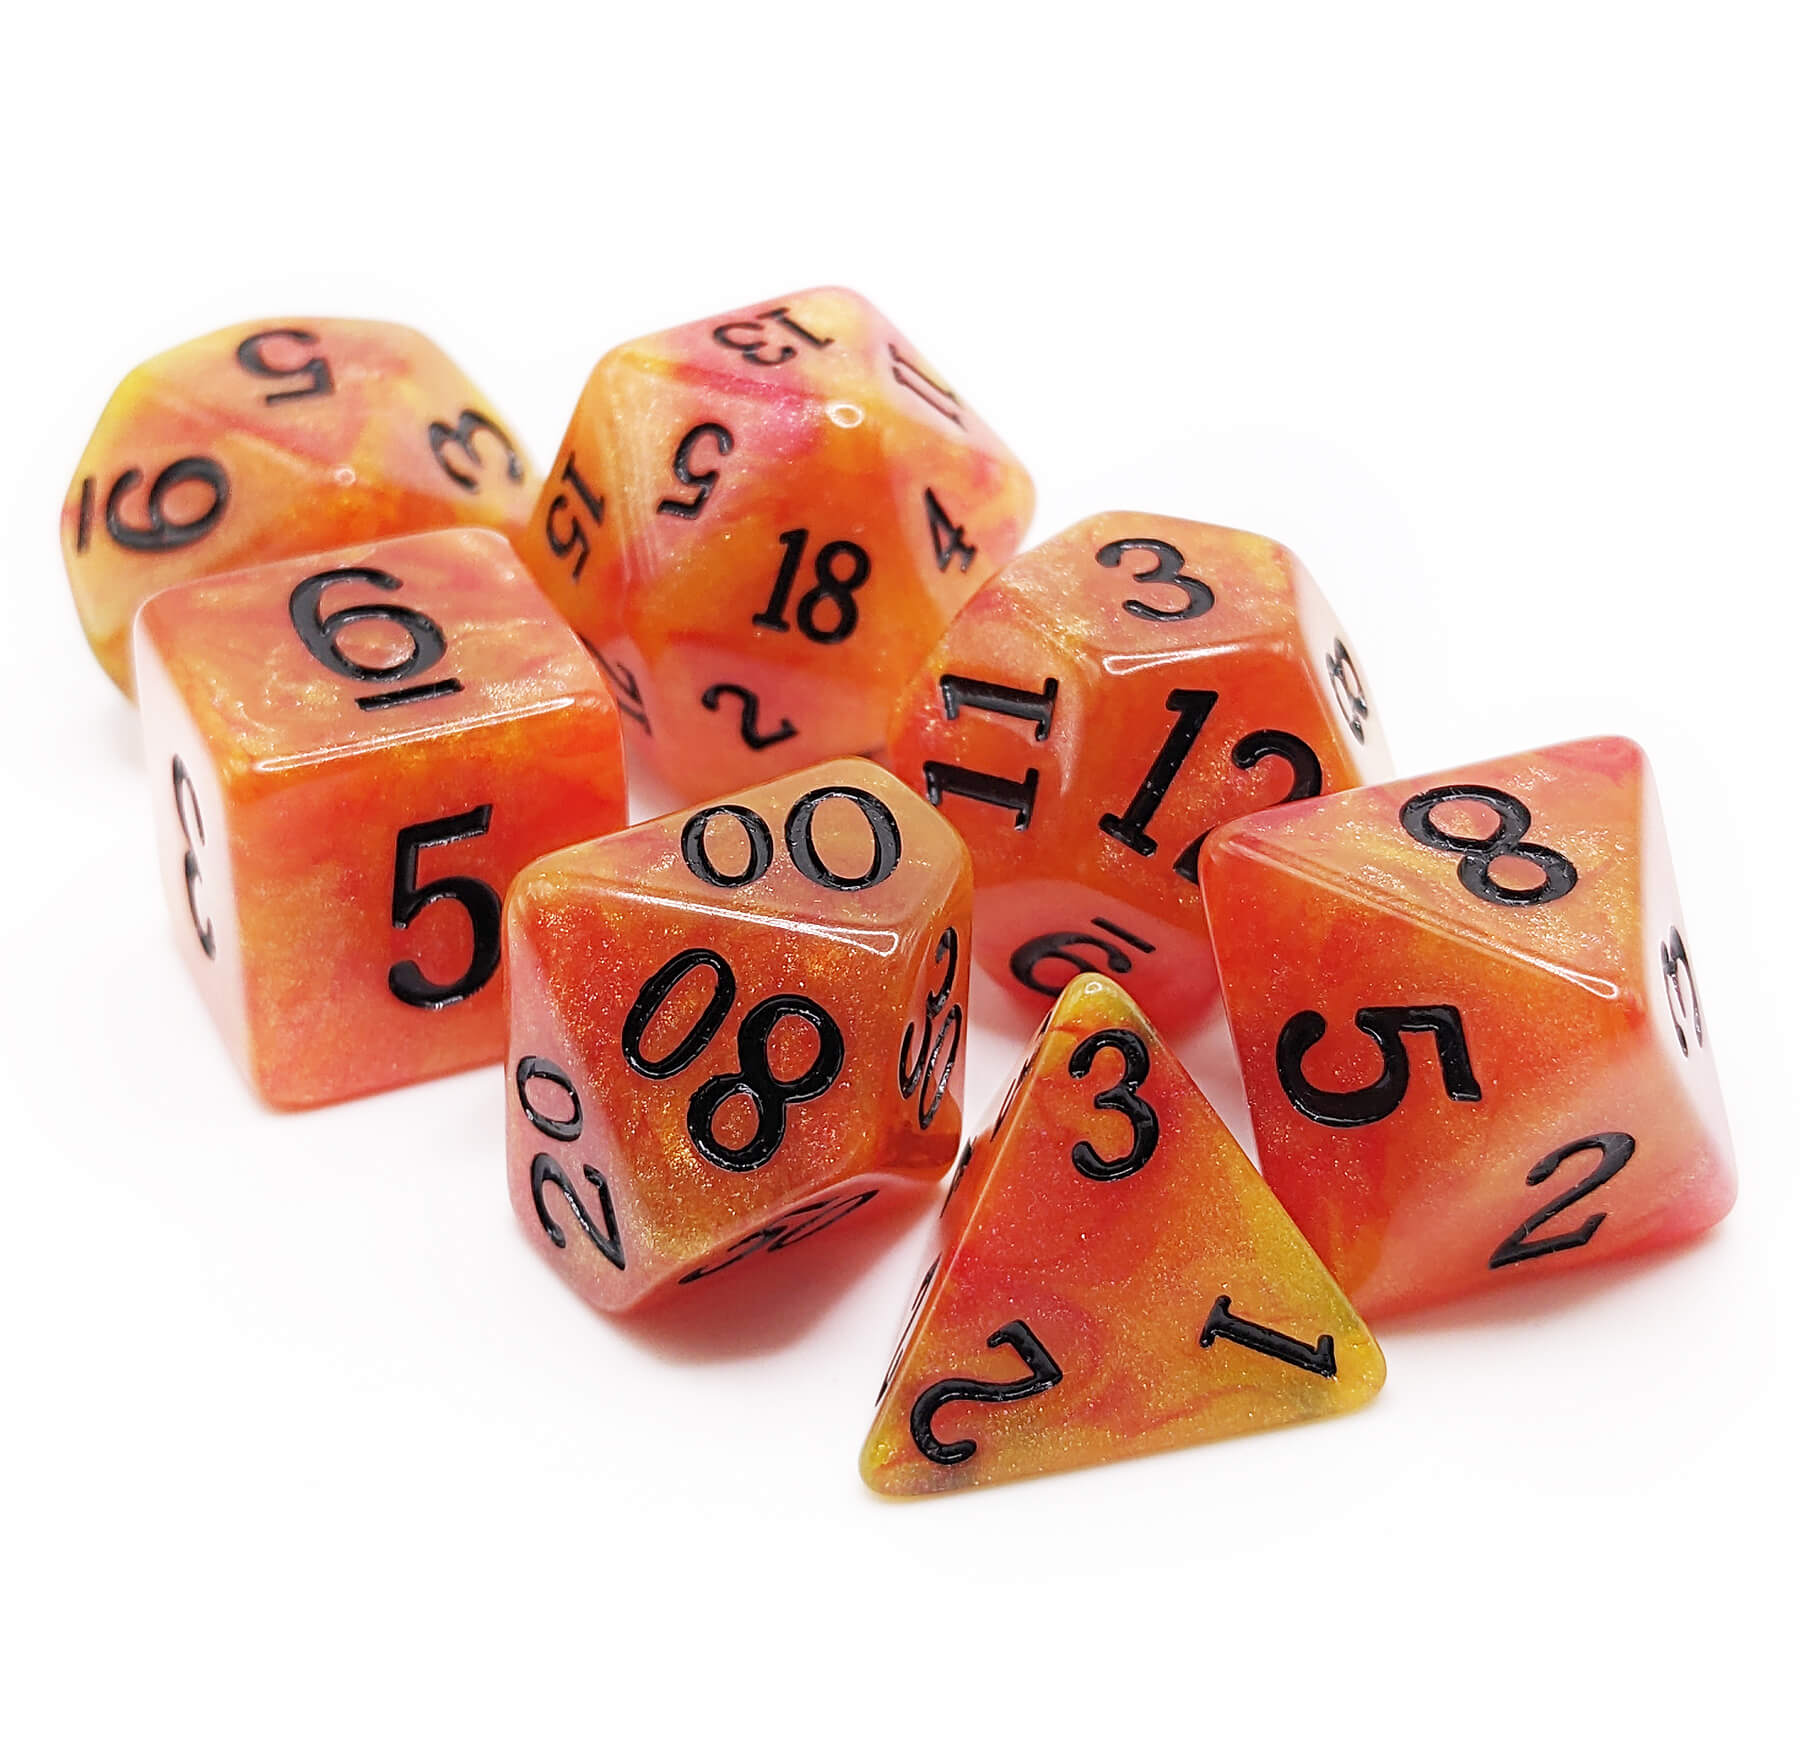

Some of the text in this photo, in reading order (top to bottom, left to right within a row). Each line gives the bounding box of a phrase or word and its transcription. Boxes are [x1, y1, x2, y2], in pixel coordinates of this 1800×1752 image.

[235, 326, 336, 406] 5
[713, 308, 835, 366] 13
[425, 406, 526, 495] 3
[657, 420, 734, 521] 5
[545, 450, 605, 582] 15
[922, 486, 978, 575] 4
[287, 565, 465, 713] 6
[751, 528, 873, 645] 18
[1094, 536, 1216, 623] 3
[699, 683, 800, 753] 2
[923, 672, 1059, 833] 11
[679, 785, 902, 892] 00
[1398, 783, 1578, 907] 8
[390, 803, 503, 1012] 5
[1067, 1028, 1161, 1183] 3
[1275, 1004, 1482, 1128] 5
[515, 1054, 626, 1272] 20
[1487, 1132, 1637, 1271] 2
[909, 1319, 1065, 1466] 2
[1199, 1294, 1337, 1378] 1
